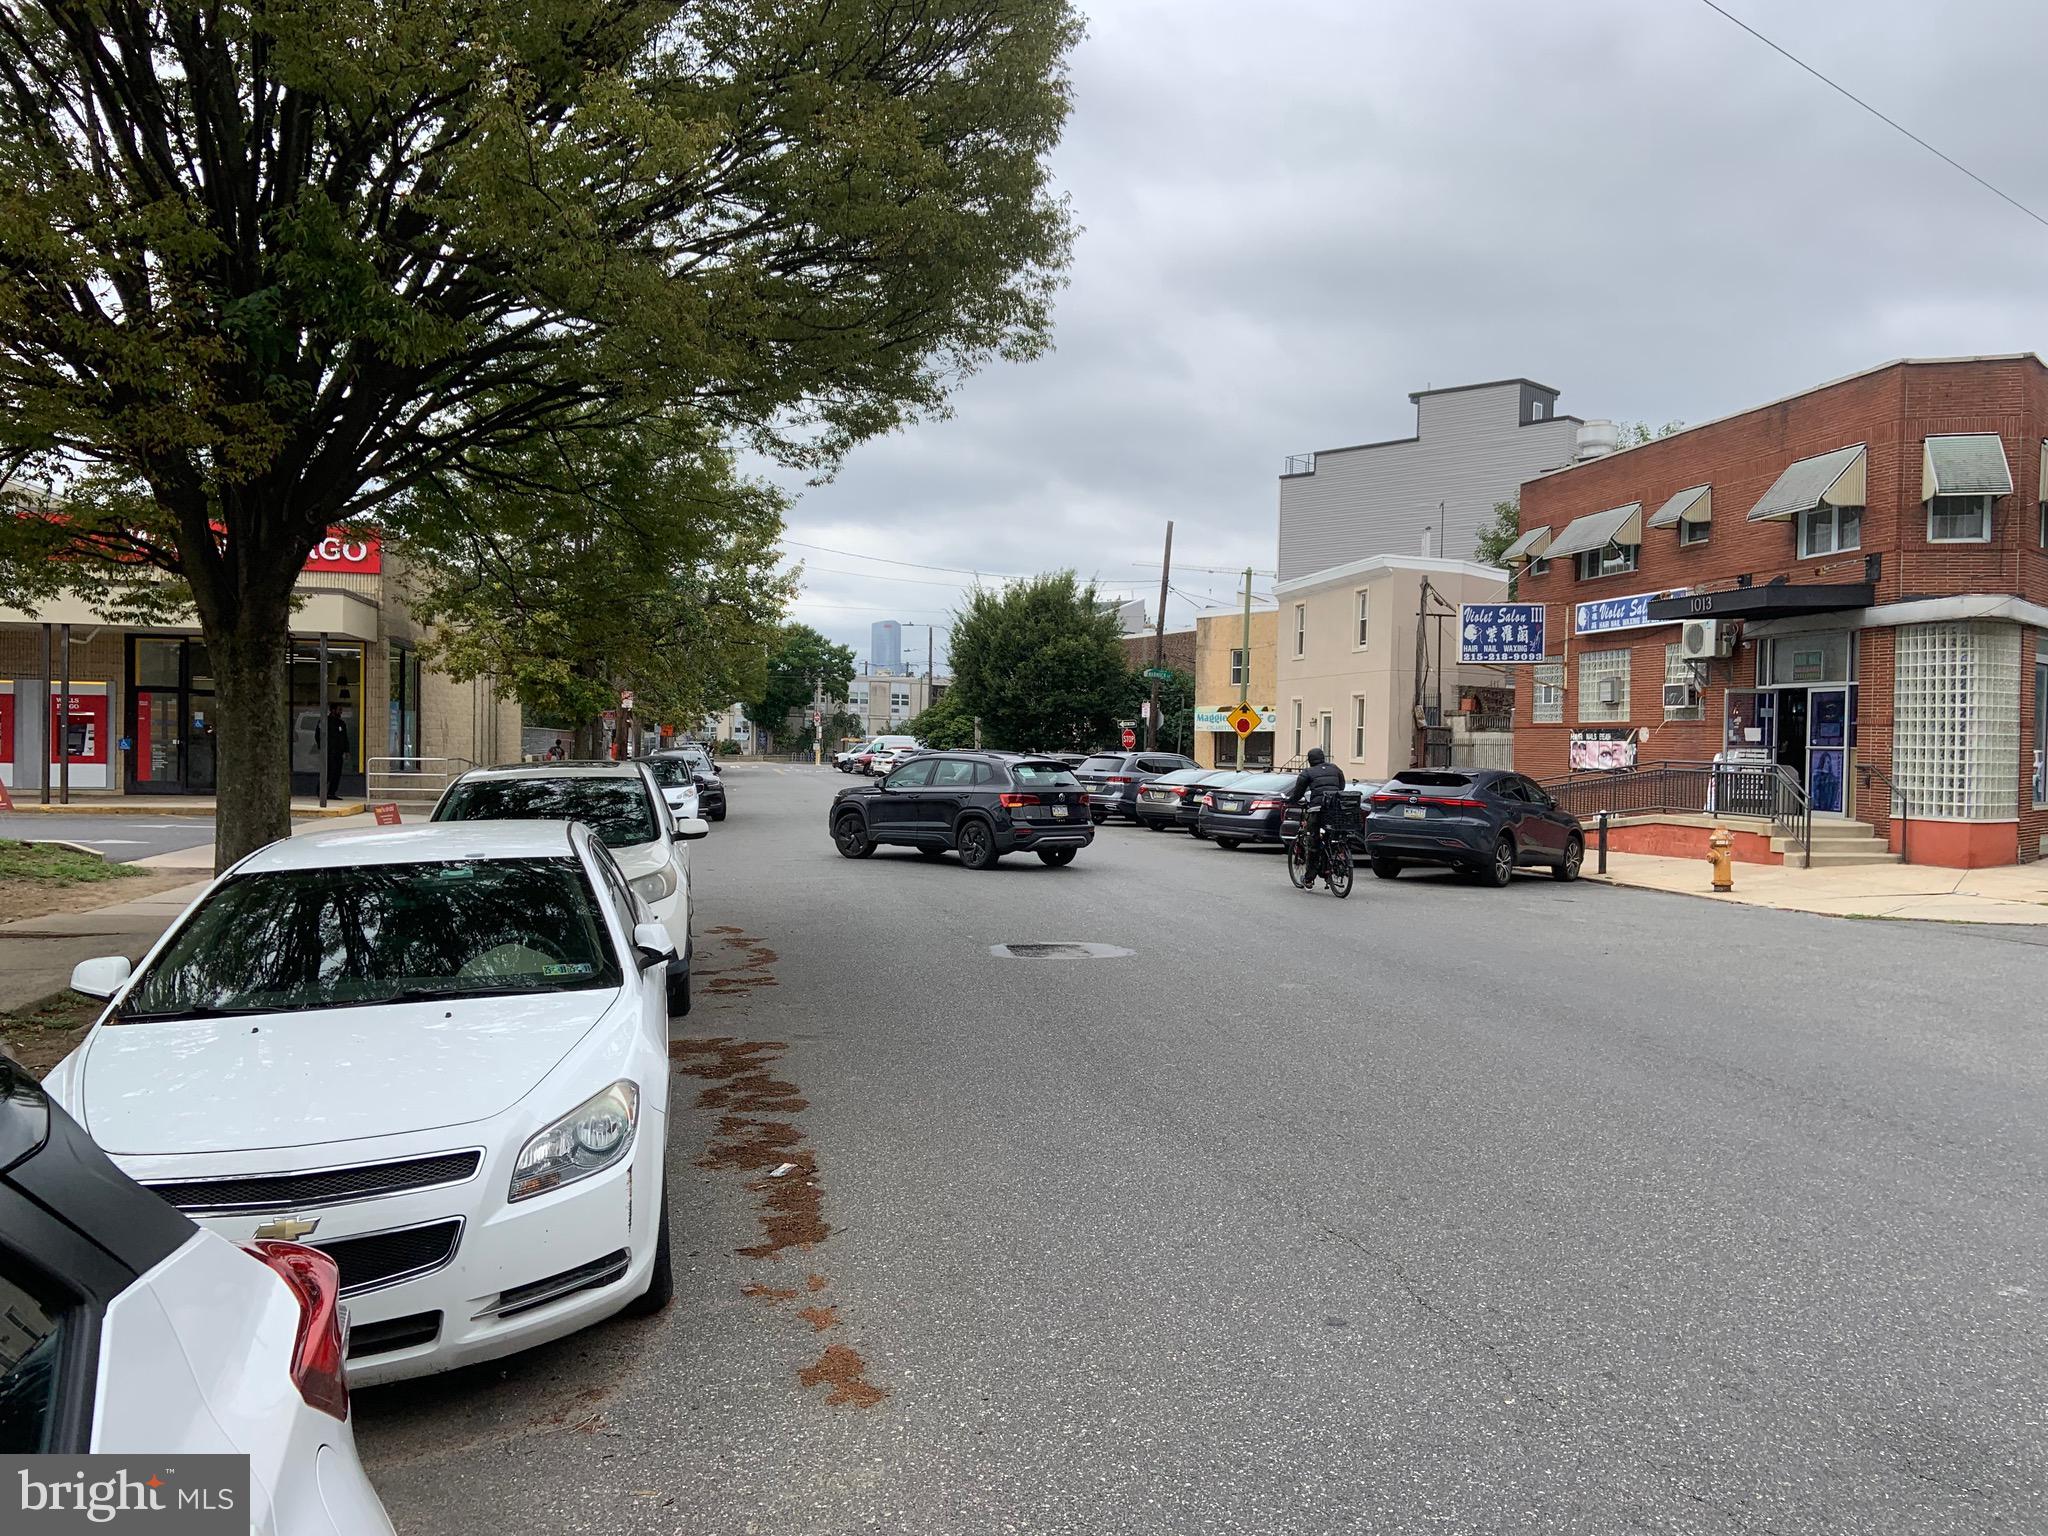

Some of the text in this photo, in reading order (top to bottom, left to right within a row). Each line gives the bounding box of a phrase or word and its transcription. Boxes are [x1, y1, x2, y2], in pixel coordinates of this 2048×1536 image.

[1599, 604, 1626, 620] Violet
[1629, 599, 1648, 617] Sal
[1690, 597, 1712, 612] 1013
[1464, 607, 1493, 623] Violet
[1497, 607, 1526, 623] Salon
[1123, 735, 1134, 743] STOP
